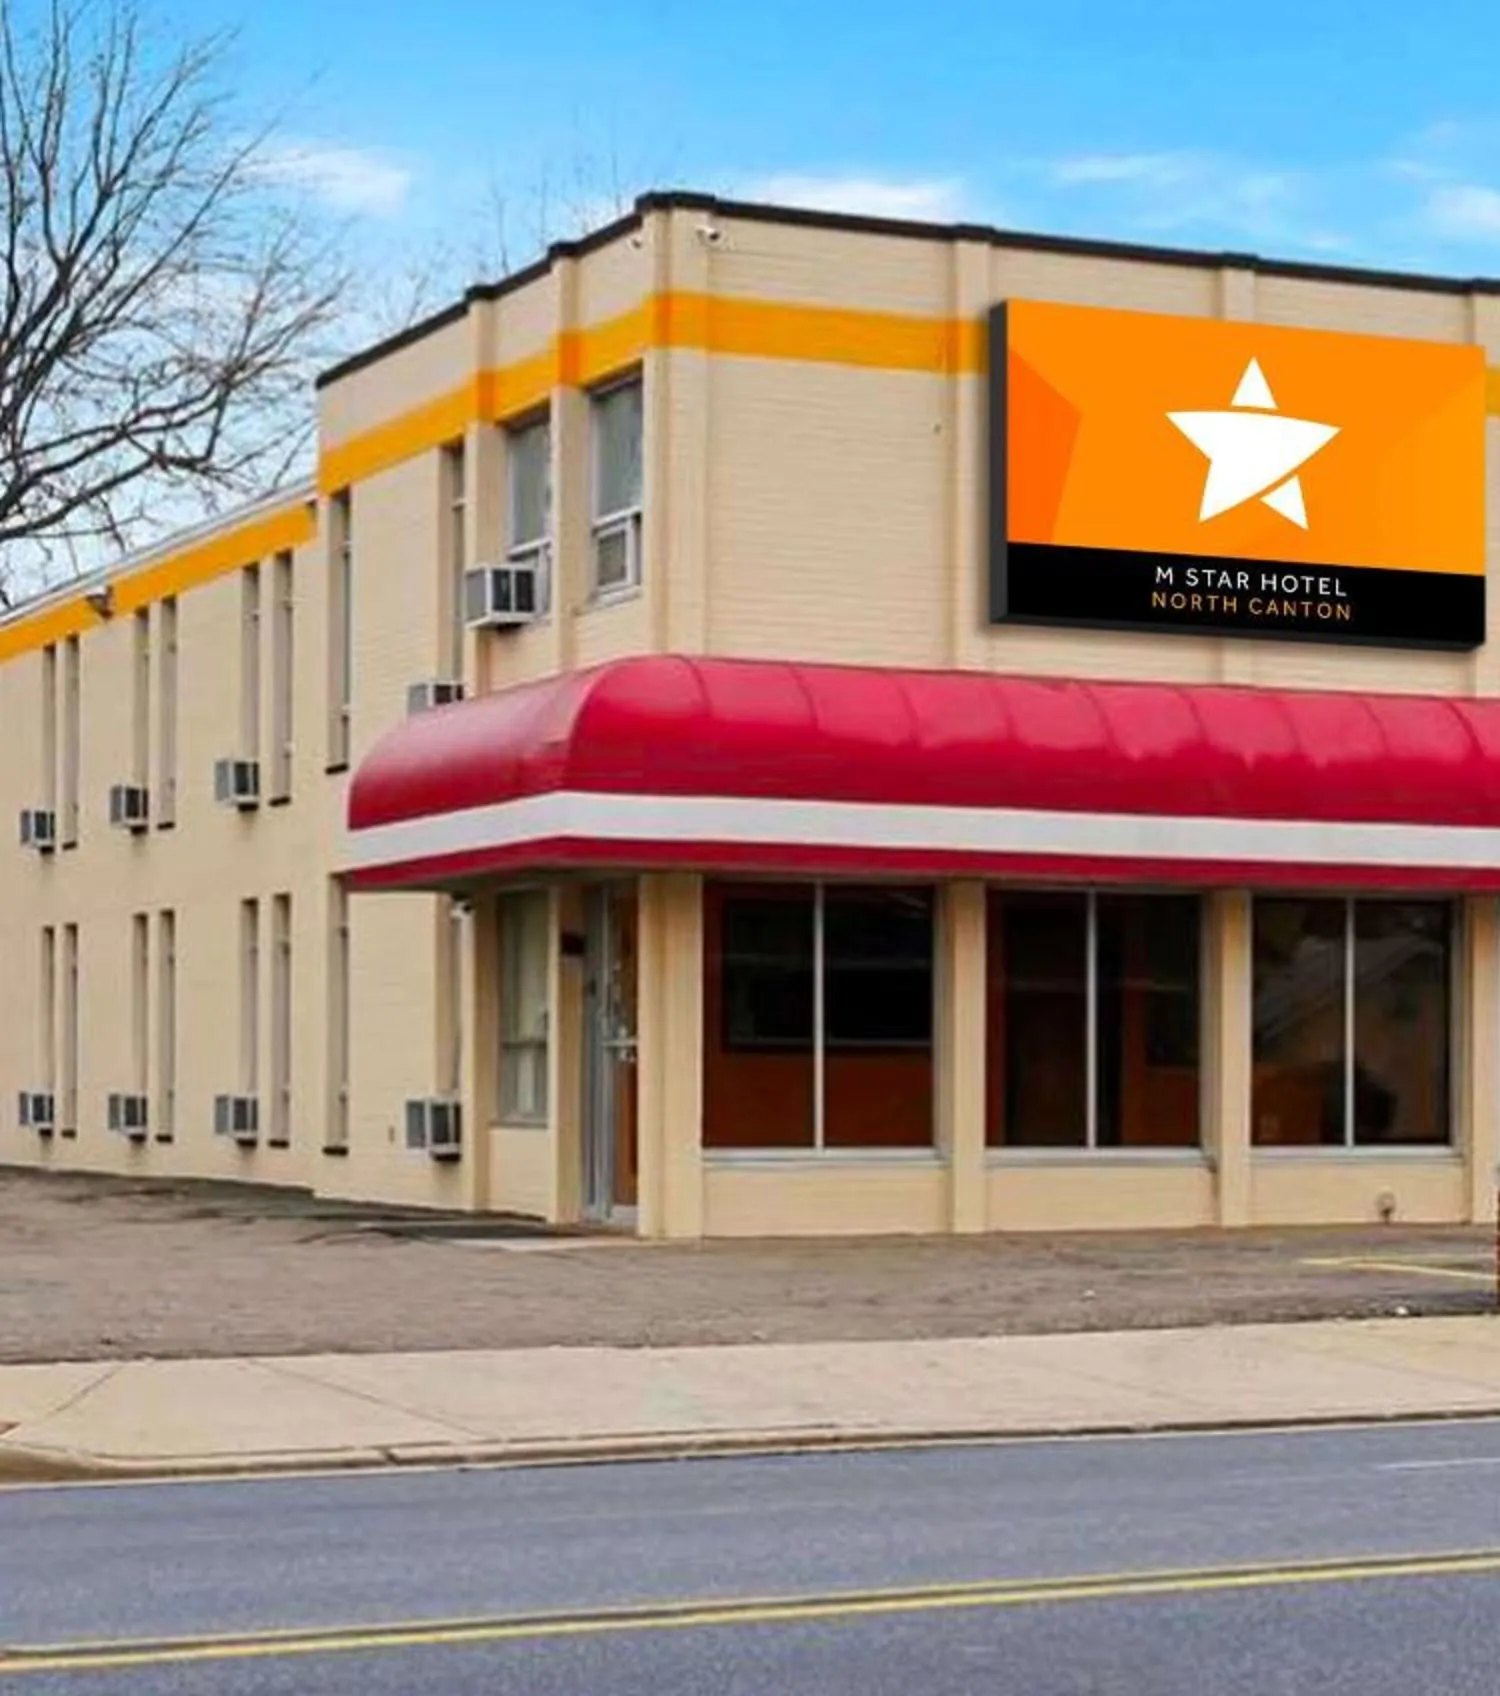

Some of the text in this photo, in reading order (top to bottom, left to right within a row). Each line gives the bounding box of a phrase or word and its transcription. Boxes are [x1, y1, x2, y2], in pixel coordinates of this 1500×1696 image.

[1155, 566, 1347, 597] M STAR HOTEL
[1152, 591, 1351, 621] NORTH CANTON
